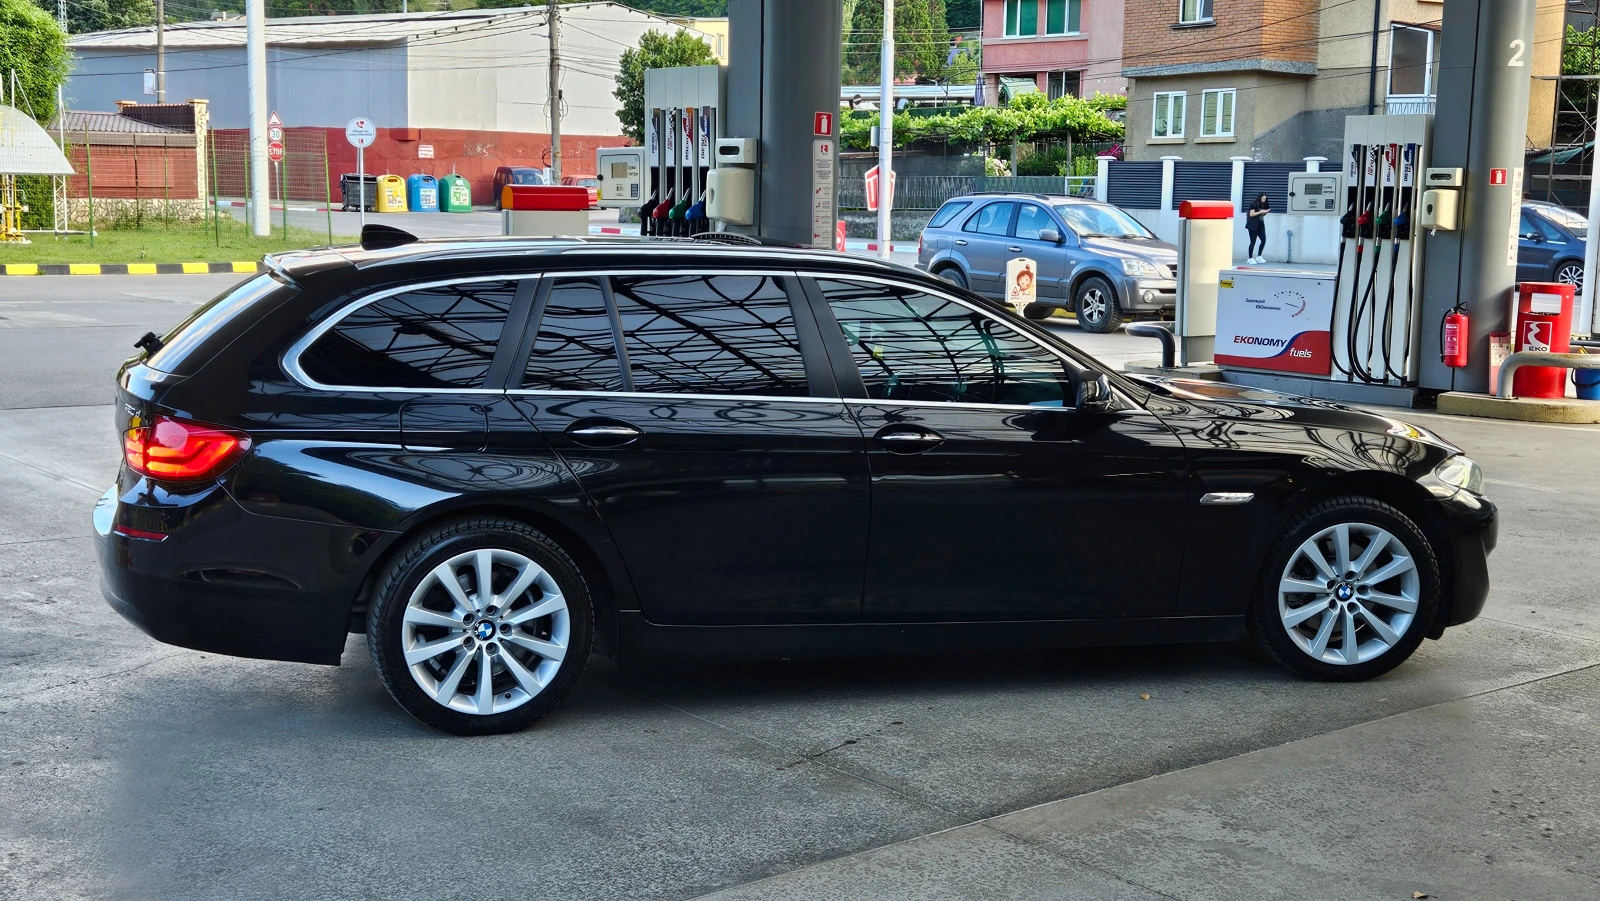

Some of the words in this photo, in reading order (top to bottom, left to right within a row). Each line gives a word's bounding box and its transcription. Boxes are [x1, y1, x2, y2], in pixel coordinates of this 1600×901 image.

[1507, 39, 1525, 67] 2
[271, 130, 280, 138] 30
[269, 147, 283, 156] STOP
[1233, 335, 1287, 348] EKONOMY
[1289, 347, 1313, 358] fuels
